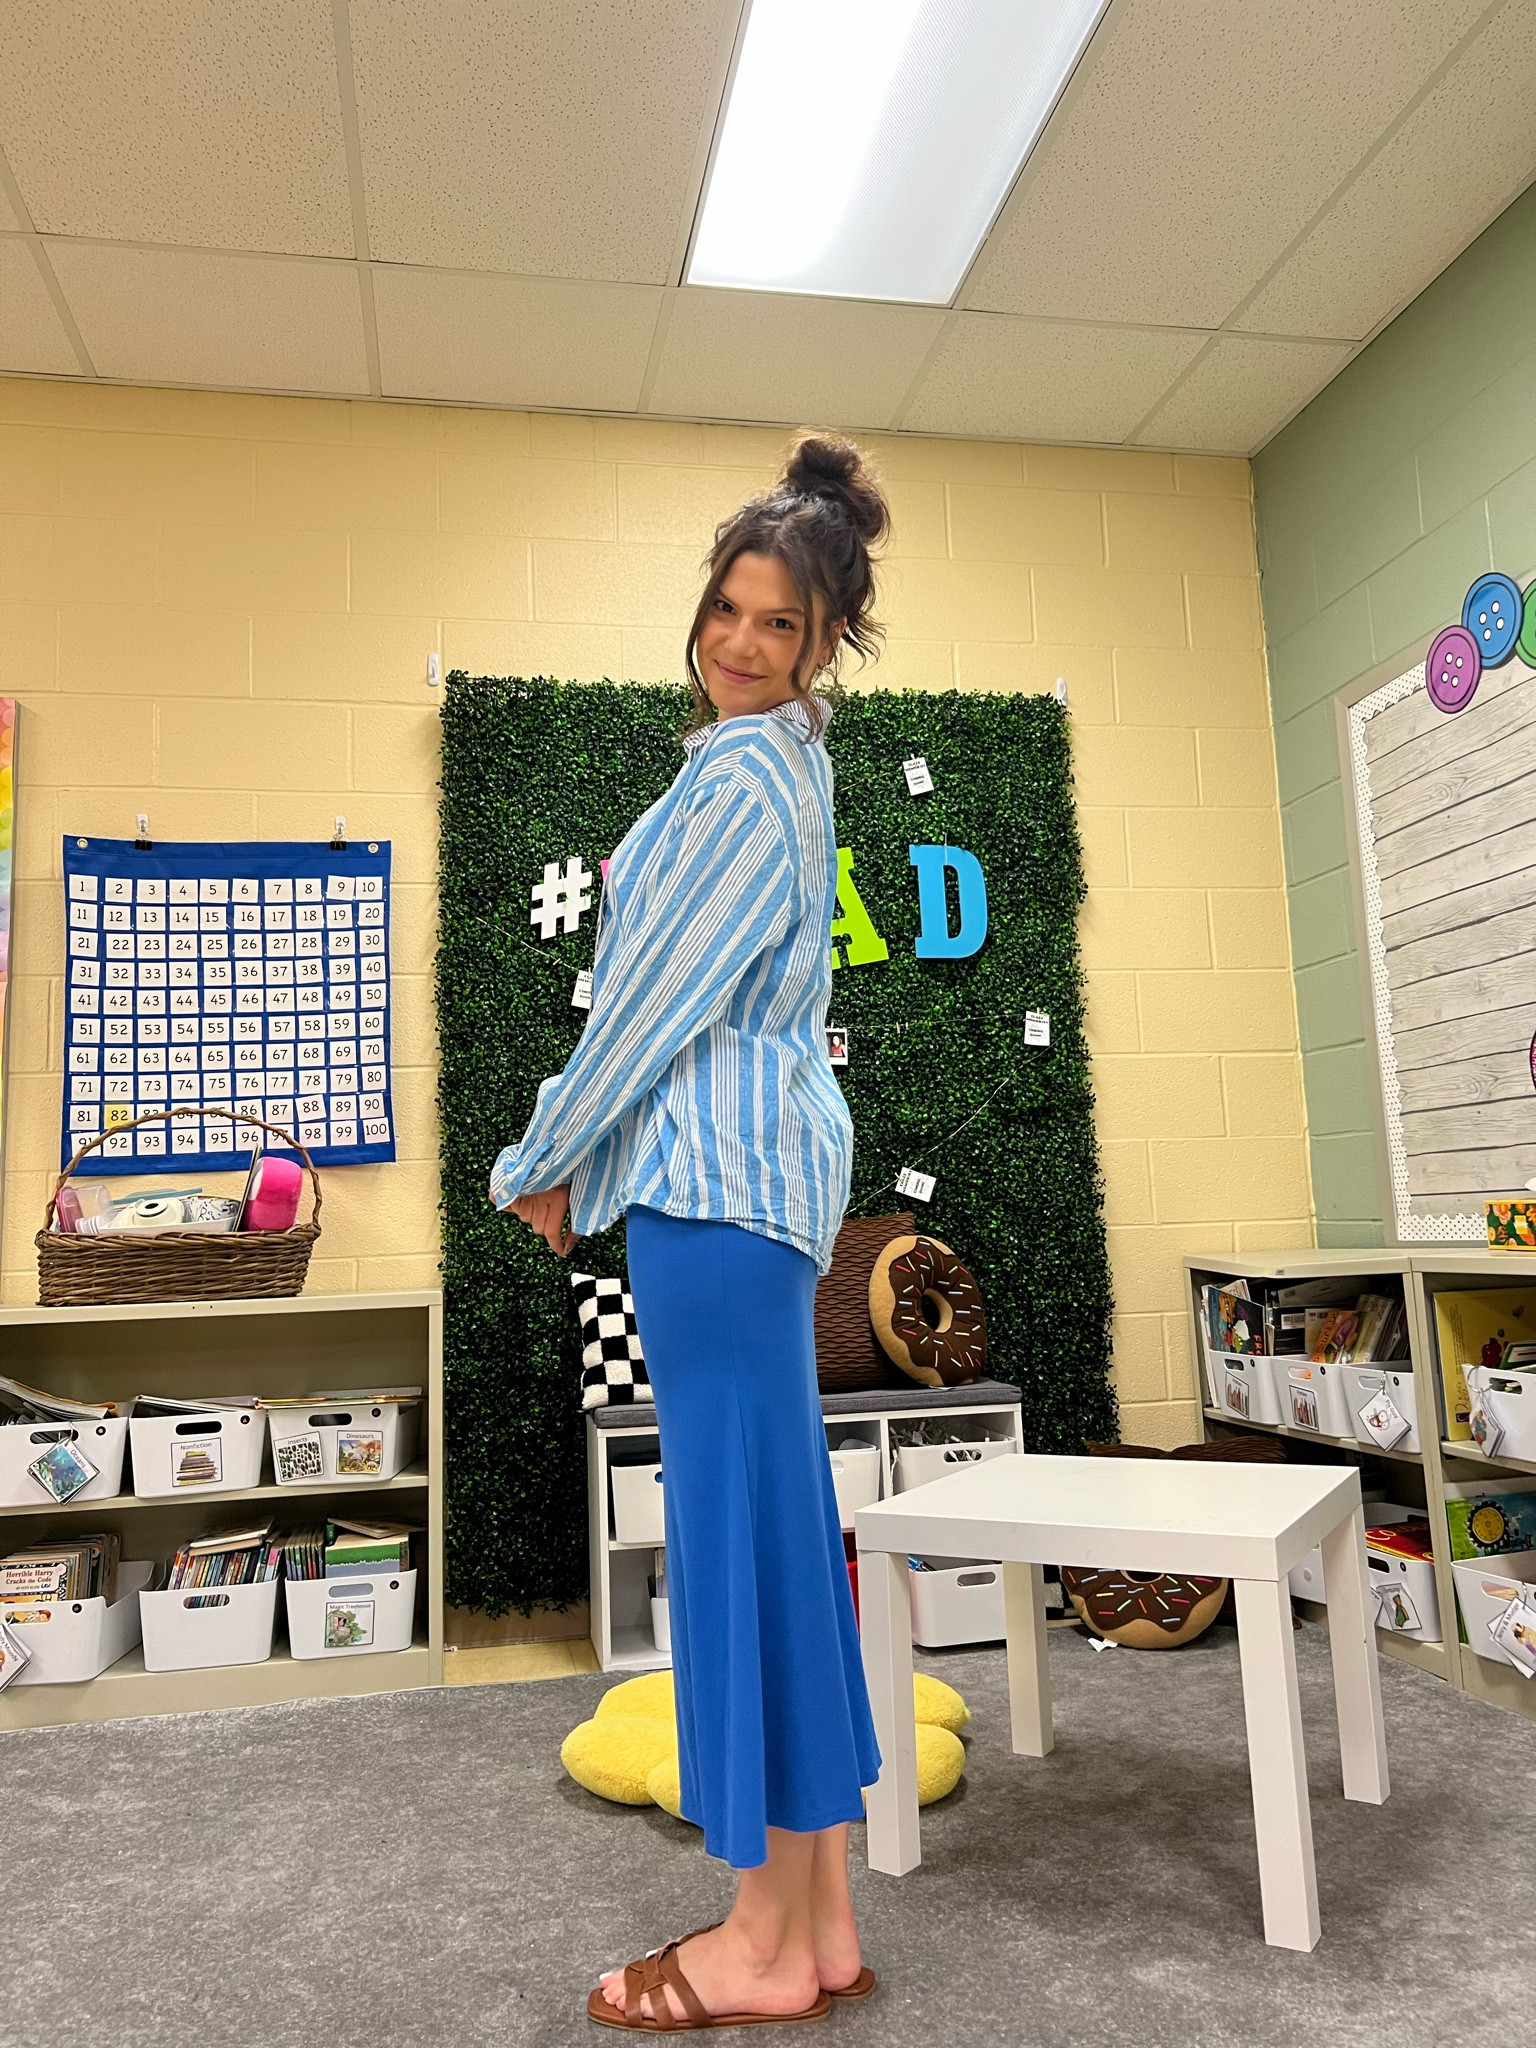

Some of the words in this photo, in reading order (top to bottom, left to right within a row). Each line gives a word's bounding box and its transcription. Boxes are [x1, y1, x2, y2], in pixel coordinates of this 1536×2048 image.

[80, 881, 85, 892] 1
[115, 883, 123, 895] 2
[148, 884, 156, 896] 3
[179, 885, 187, 896] 4
[209, 884, 217, 895] 5
[241, 884, 249, 895] 6
[273, 884, 282, 895] 7
[304, 883, 313, 895] 8
[337, 881, 346, 893] 9
[362, 881, 376, 893] 10
[77, 908, 87, 920] 11
[109, 911, 123, 922] 12
[143, 912, 157, 923] 13
[176, 912, 190, 923] 14
[206, 912, 219, 923] 15
[241, 911, 255, 922] 16
[272, 911, 286, 922] 17
[303, 910, 317, 922] 18
[333, 909, 346, 921] 19
[365, 907, 380, 919] 20
[77, 937, 90, 949] 21
[112, 939, 130, 950] 22
[144, 939, 160, 951] 23
[176, 939, 192, 951] 24
[207, 939, 223, 950] 25
[241, 938, 257, 950] 26
[273, 938, 289, 949] 27
[301, 937, 317, 948] 28
[335, 936, 350, 947] 29
[365, 934, 380, 946] 30
[79, 966, 92, 978] 31
[112, 968, 129, 979] 32
[145, 968, 161, 980] 33
[176, 967, 192, 979] 34
[210, 967, 226, 978] 35
[242, 966, 258, 977] 36
[272, 966, 288, 977] 37
[301, 964, 318, 976] 38
[335, 963, 351, 975] 39
[366, 961, 381, 973] 40
[77, 994, 91, 1006] 41
[109, 995, 128, 1007] 42
[142, 995, 160, 1007] 43
[176, 995, 193, 1006] 44
[210, 994, 226, 1005] 45
[242, 993, 259, 1004] 46
[272, 992, 288, 1004] 47
[302, 991, 319, 1003] 48
[335, 990, 351, 1002] 49
[366, 988, 382, 1000] 50
[80, 1023, 93, 1035] 51
[110, 1024, 128, 1035] 52
[144, 1024, 161, 1035] 53
[177, 1023, 194, 1035] 54
[208, 1022, 225, 1034] 55
[240, 1022, 256, 1033] 56
[274, 1021, 291, 1033] 57
[304, 1019, 321, 1031] 58
[334, 1018, 350, 1030] 59
[364, 1017, 380, 1028] 60
[76, 1052, 90, 1064] 61
[110, 1052, 127, 1064] 62
[143, 1052, 160, 1064] 63
[174, 1052, 191, 1063] 64
[207, 1050, 224, 1062] 65
[240, 1049, 257, 1061] 66
[272, 1049, 288, 1060] 67
[303, 1047, 319, 1059] 68
[335, 1046, 351, 1057] 69
[365, 1043, 380, 1056] 70
[78, 1081, 93, 1093] 71
[110, 1081, 128, 1093] 72
[144, 1080, 161, 1092] 73
[177, 1079, 193, 1091] 74
[209, 1077, 226, 1089] 75
[242, 1077, 259, 1089] 76
[271, 1076, 288, 1088] 77
[304, 1074, 321, 1086] 78
[335, 1073, 352, 1085] 79
[367, 1071, 382, 1083] 80
[77, 1110, 91, 1122] 81
[110, 1109, 129, 1122] 82
[240, 1104, 257, 1115] 86
[271, 1104, 288, 1116] 87
[302, 1100, 320, 1113] 88
[335, 1101, 352, 1113] 89
[364, 1098, 380, 1111] 90
[109, 1137, 128, 1149] 92
[143, 1136, 160, 1148] 93
[177, 1134, 194, 1146] 94
[211, 1132, 228, 1144] 95
[241, 1131, 259, 1143] 96
[304, 1128, 322, 1140] 98
[336, 1126, 352, 1138] 99
[365, 1123, 387, 1136] 100
[180, 1441, 213, 1450] Nonfiction
[287, 1436, 308, 1444] Insects
[70, 1449, 86, 1468] Oceans
[6, 1570, 32, 1578] Horrible
